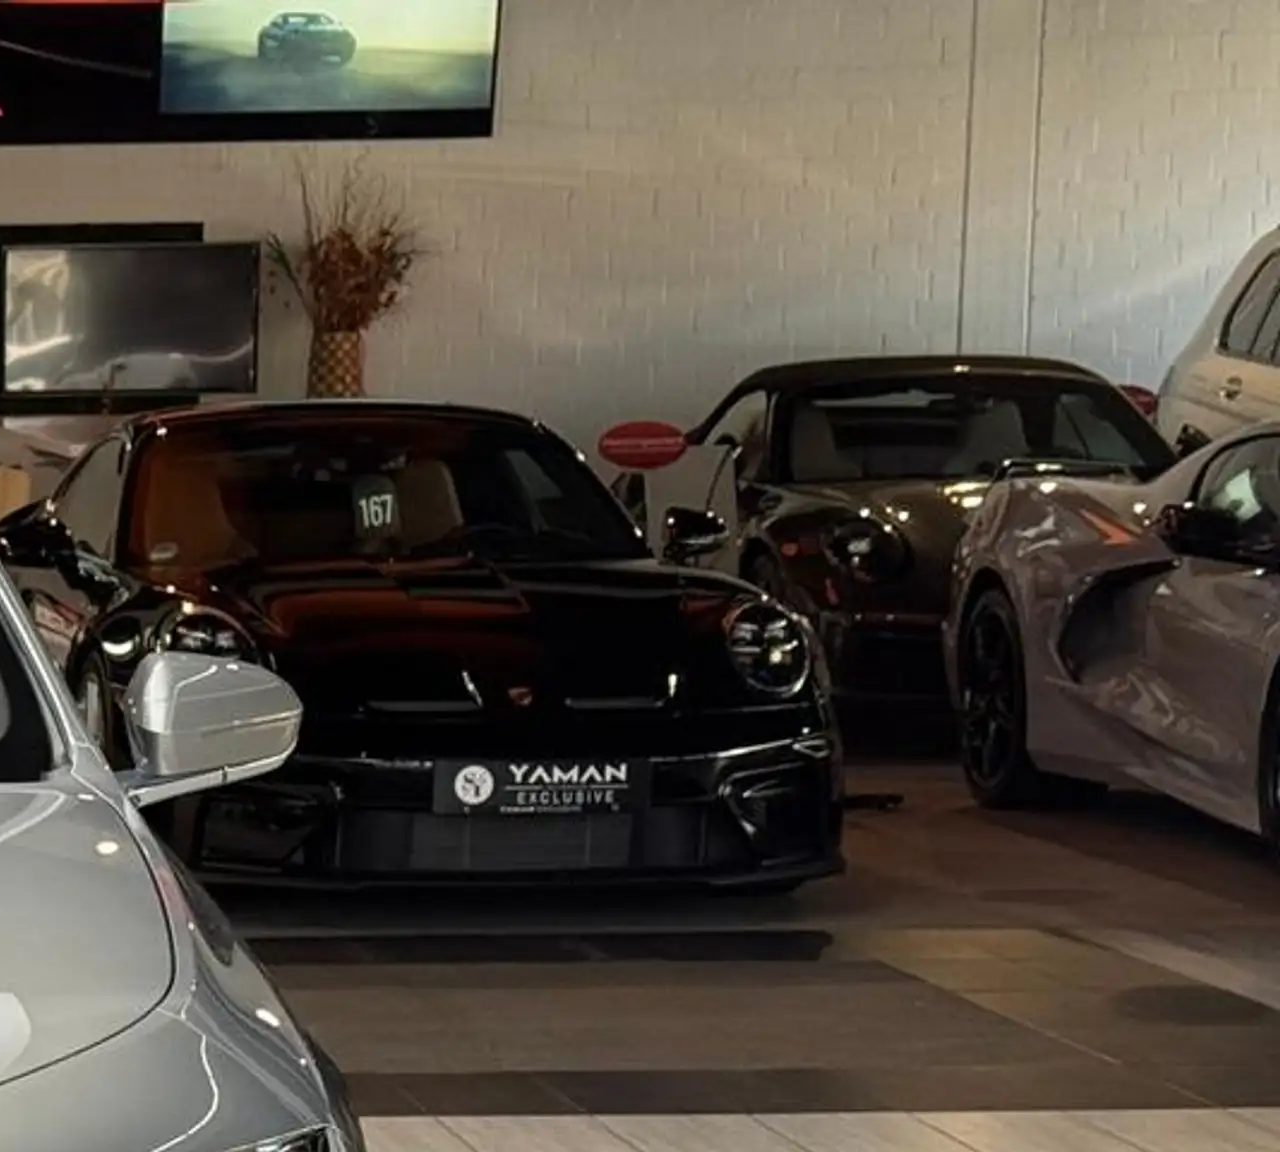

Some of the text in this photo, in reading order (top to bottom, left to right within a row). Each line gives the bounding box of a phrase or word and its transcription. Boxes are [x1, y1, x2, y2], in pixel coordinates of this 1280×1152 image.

[358, 494, 393, 528] 167
[508, 763, 628, 784] YAMAN
[516, 790, 614, 805] EXCLUSIVE
